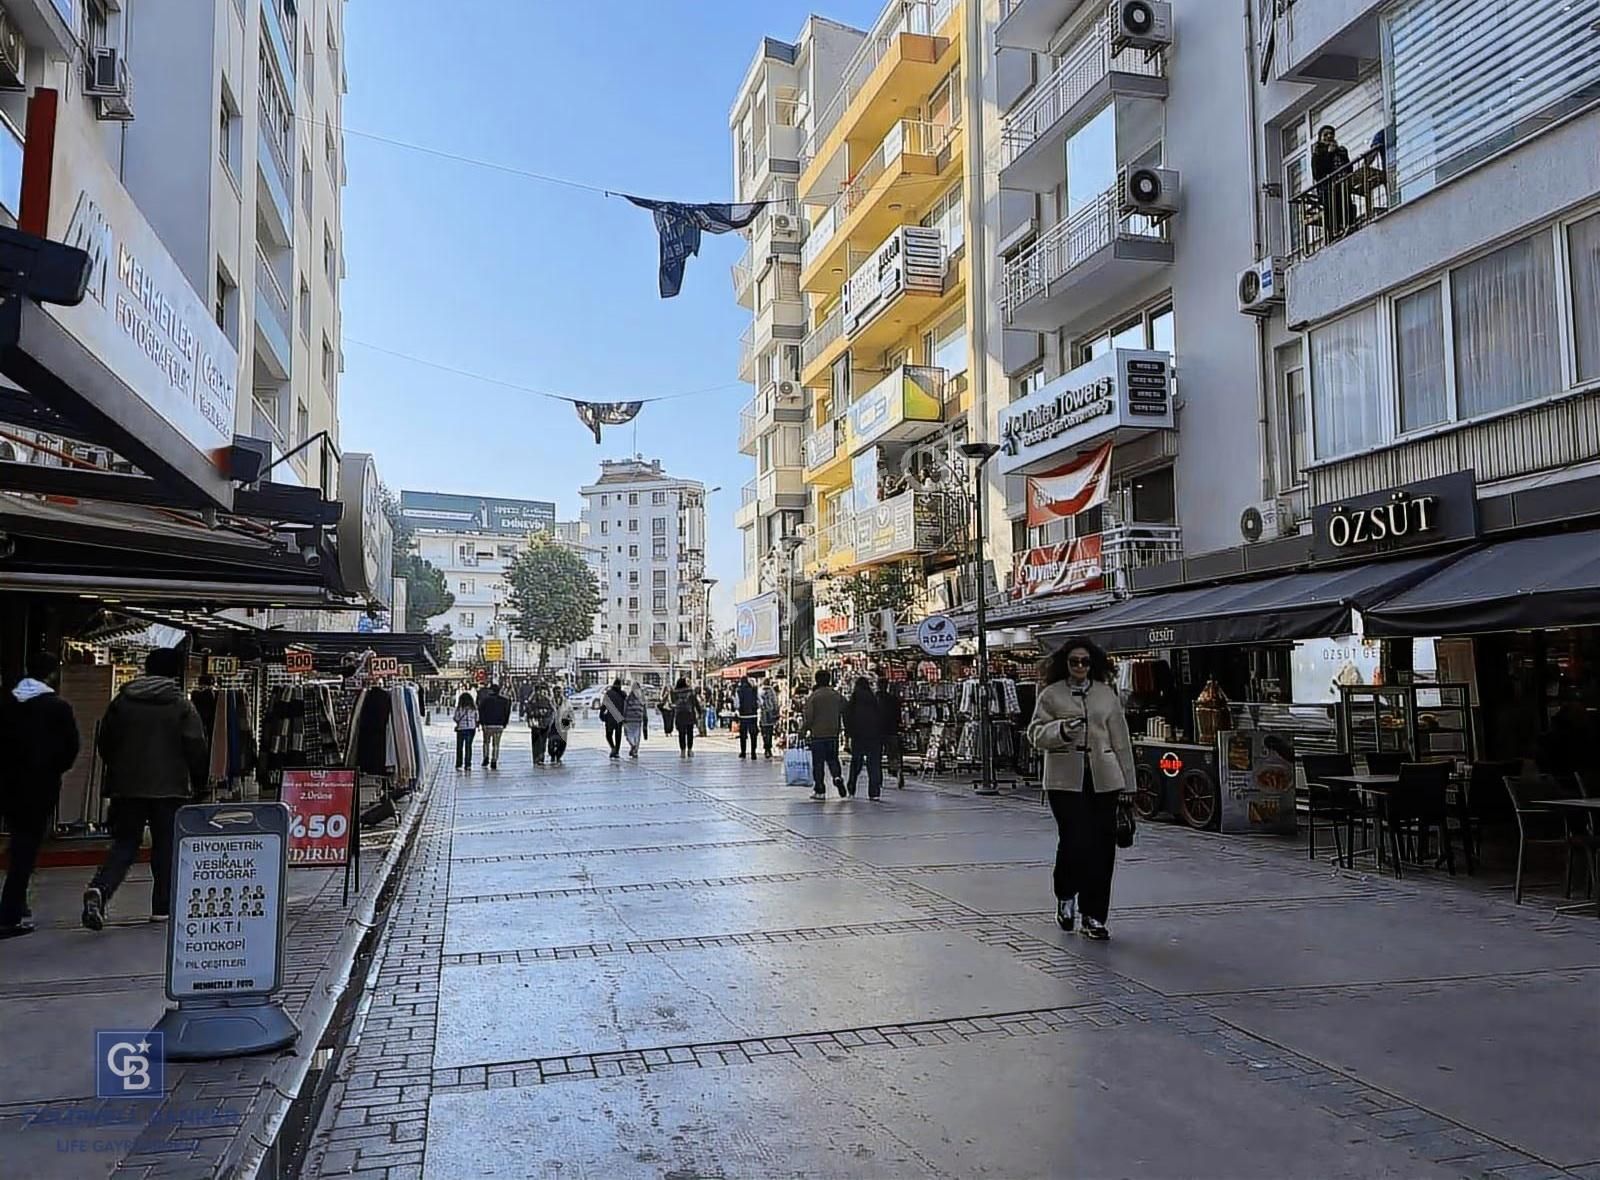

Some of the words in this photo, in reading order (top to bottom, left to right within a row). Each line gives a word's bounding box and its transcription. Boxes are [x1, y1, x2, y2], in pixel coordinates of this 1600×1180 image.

[118, 242, 193, 363] MEHMETLER
[1056, 376, 1112, 416] Towers
[1329, 491, 1434, 547] ÖZSÜT
[1149, 627, 1174, 642] ÖZSÜT
[287, 655, 311, 669] 300
[372, 659, 396, 671] 200
[288, 814, 347, 839] %50
[192, 839, 263, 853] BİYOMETRİK
[288, 844, 346, 862] DİRİM
[195, 858, 255, 870] VESİKALIK
[185, 938, 246, 952] FOTOKOPİ
